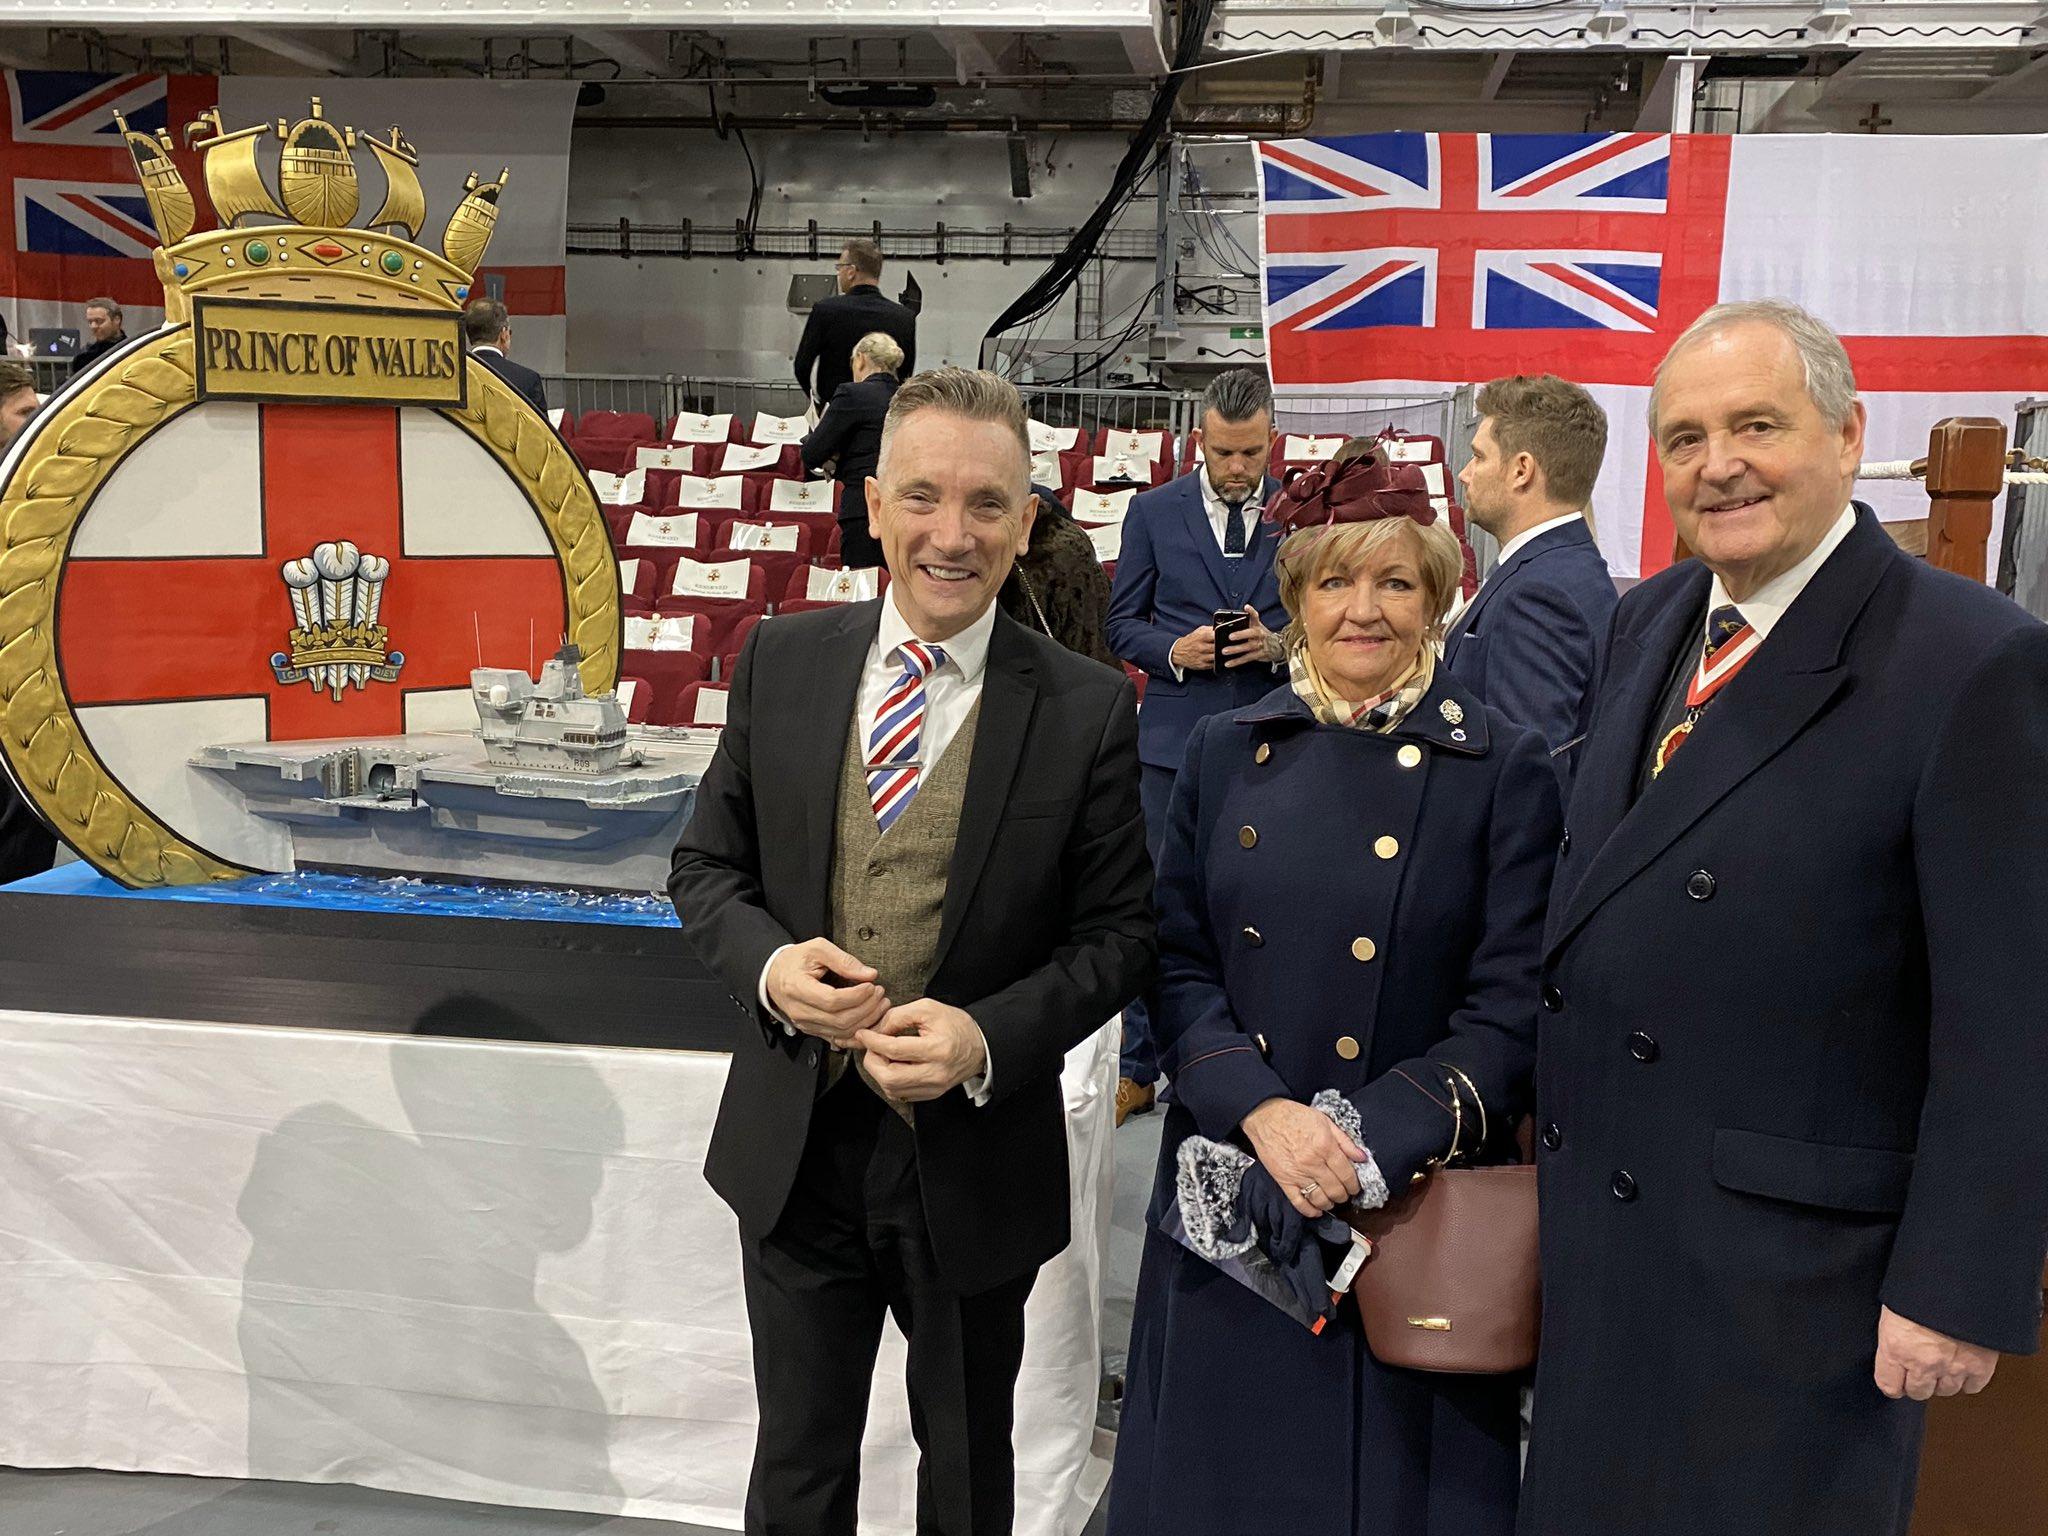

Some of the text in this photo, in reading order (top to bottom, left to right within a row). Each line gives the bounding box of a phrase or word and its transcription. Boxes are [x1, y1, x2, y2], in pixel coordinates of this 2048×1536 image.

[204, 327, 455, 380] PRINCE OF WALES
[281, 666, 397, 681] ICH DIEN
